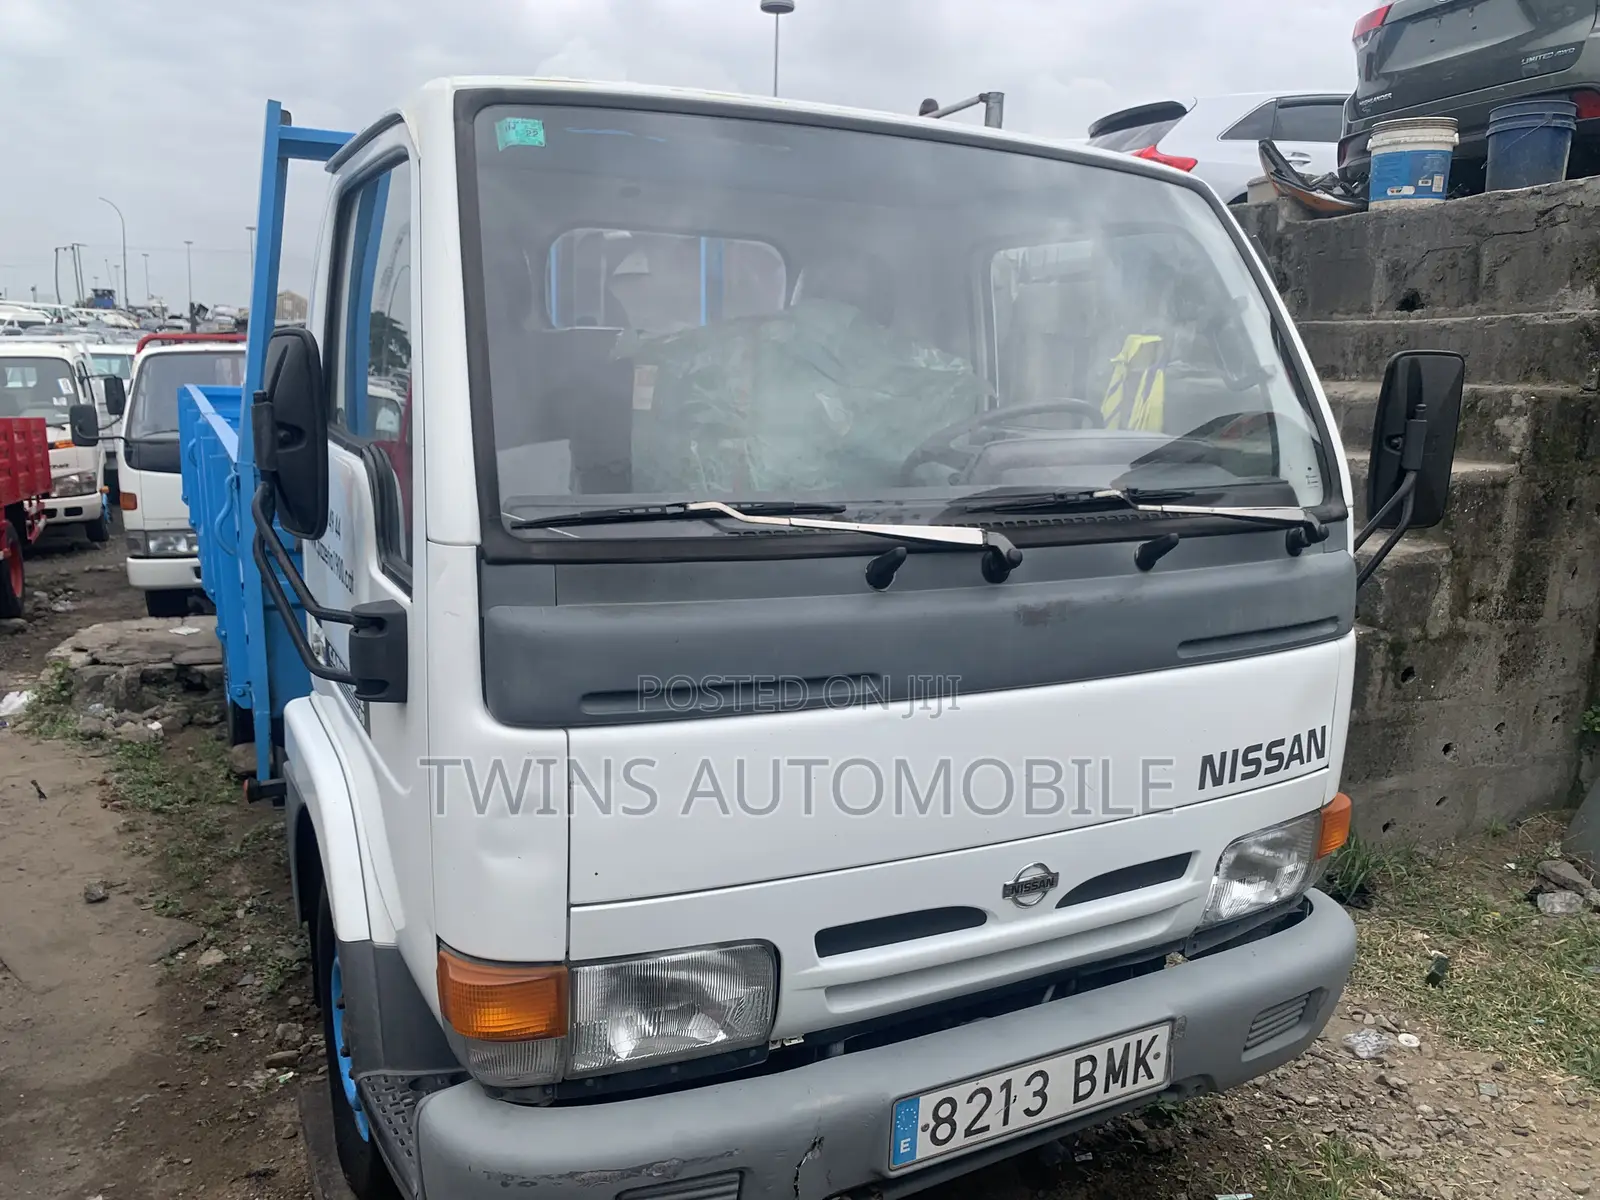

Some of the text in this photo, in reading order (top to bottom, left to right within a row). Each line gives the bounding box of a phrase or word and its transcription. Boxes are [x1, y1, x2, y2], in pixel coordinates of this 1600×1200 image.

[1198, 725, 1327, 791] NISSAN
[1010, 877, 1055, 895] NISSAN
[929, 1034, 1160, 1147] 8213 BMK
[899, 1137, 911, 1154] E
